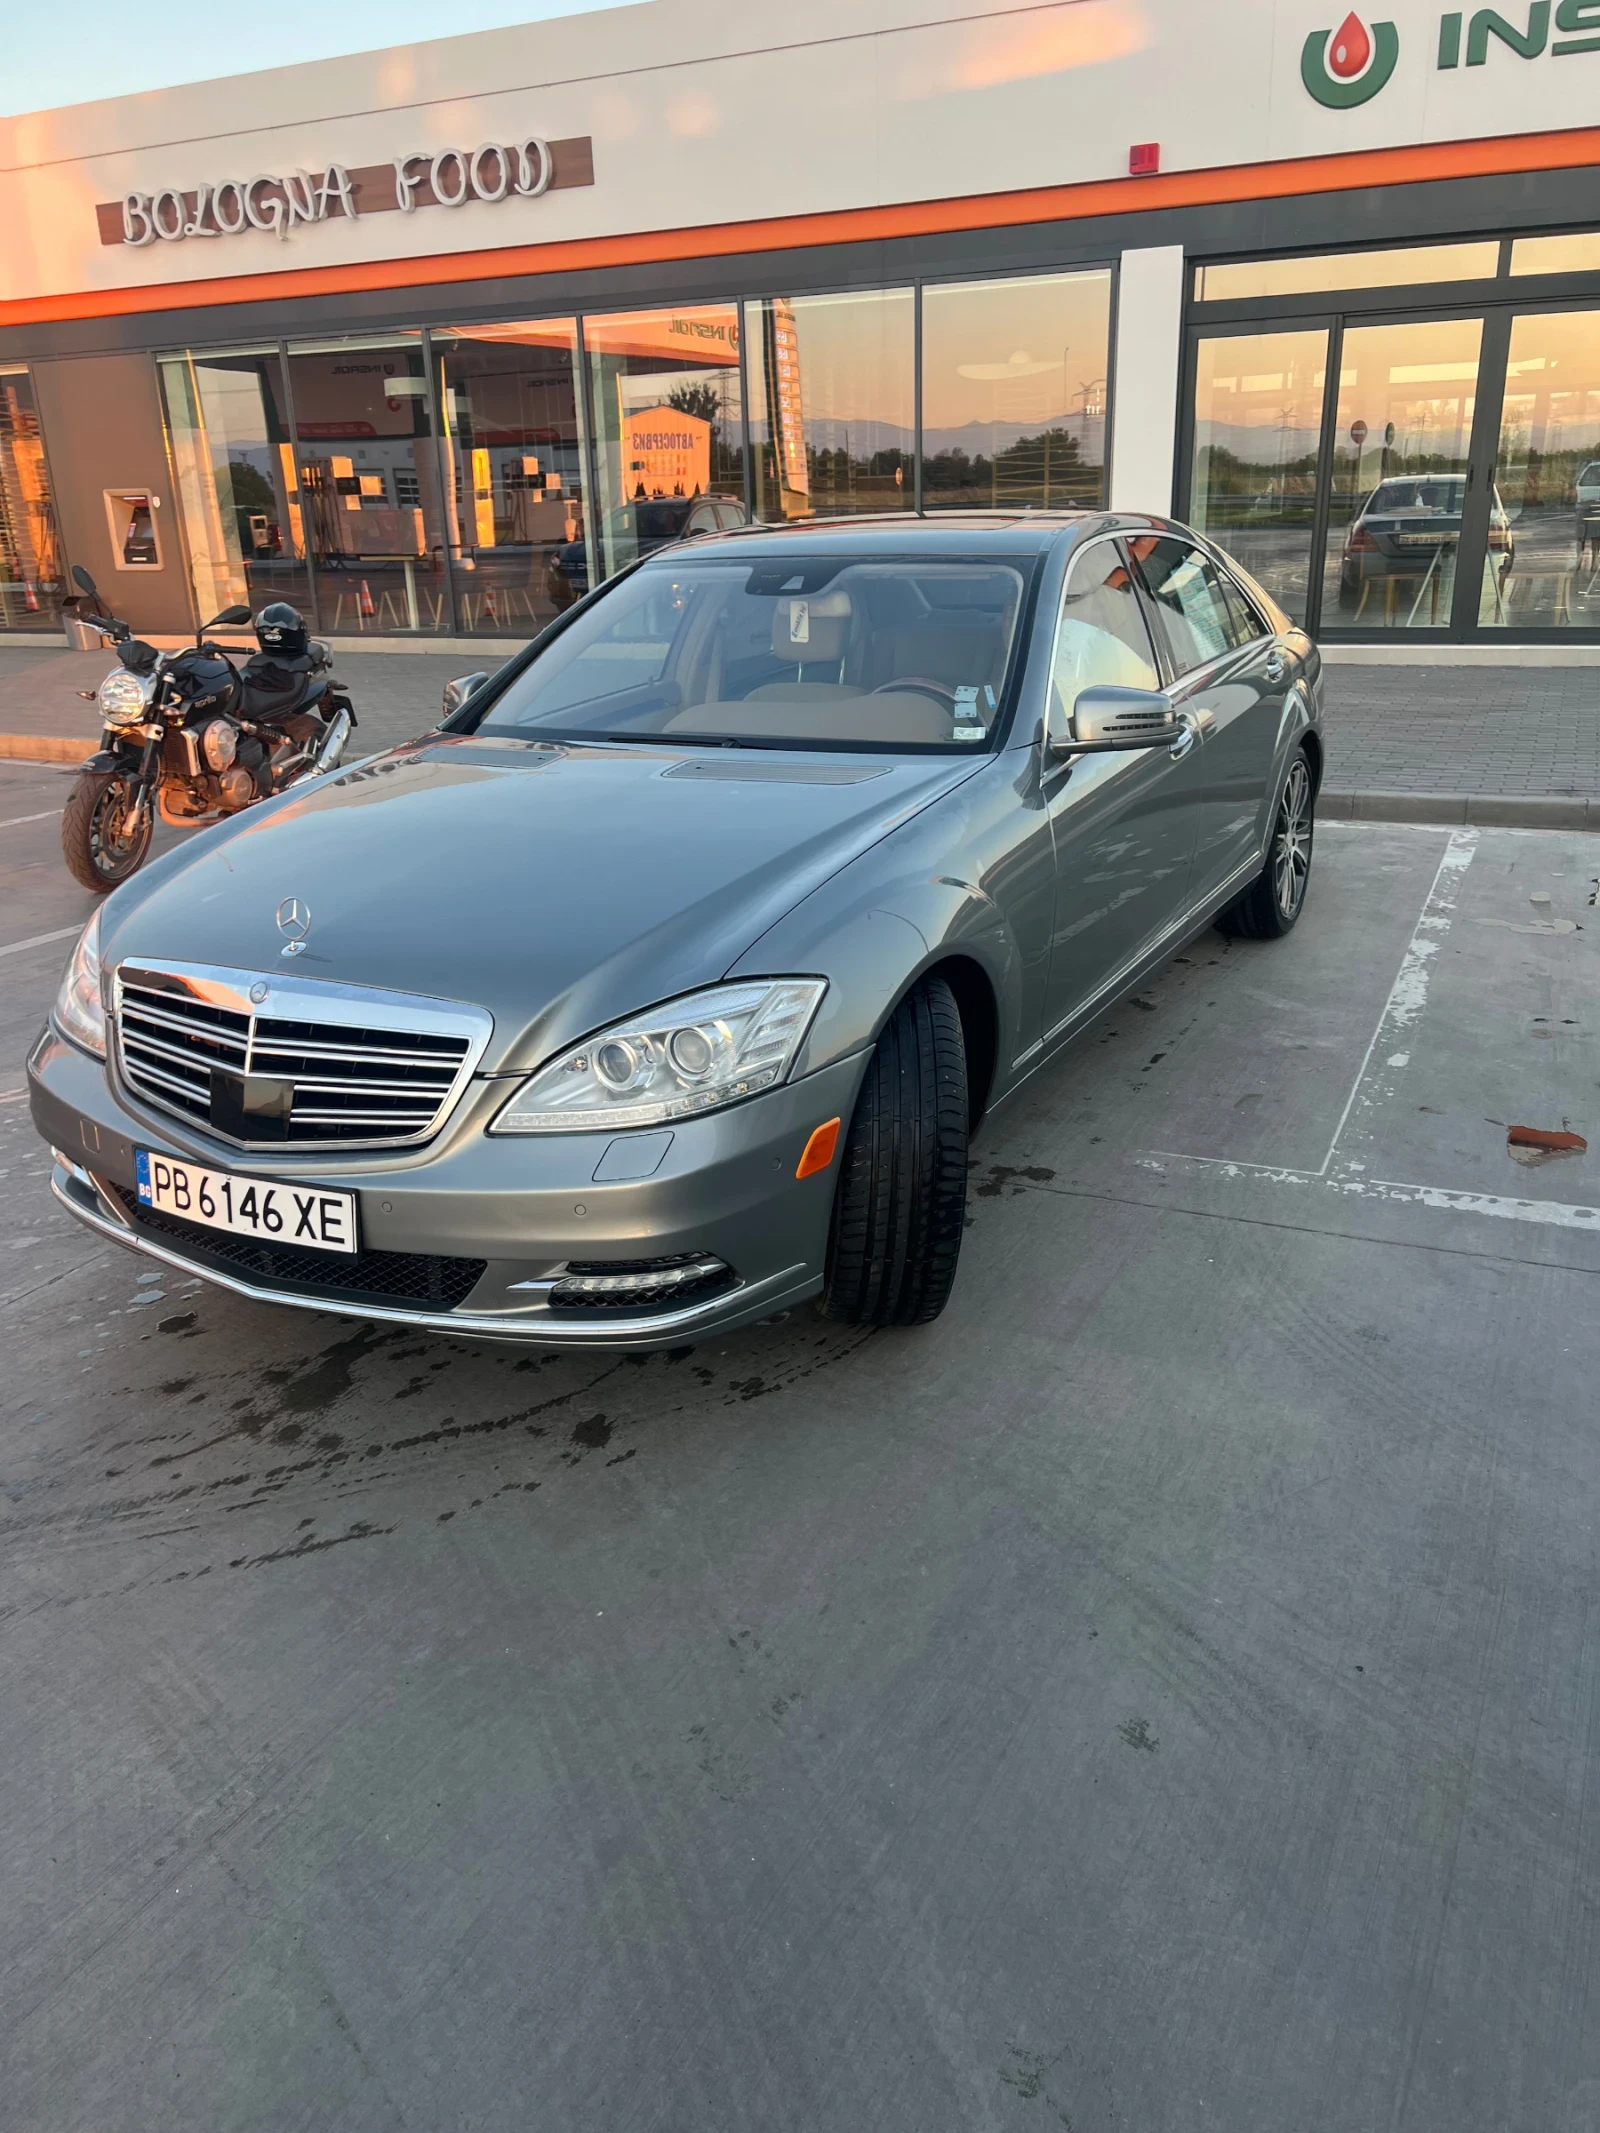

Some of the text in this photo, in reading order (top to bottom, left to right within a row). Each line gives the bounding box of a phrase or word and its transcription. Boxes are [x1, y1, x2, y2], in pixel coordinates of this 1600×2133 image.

[123, 137, 553, 246] BOLOGNA FOOD
[139, 1183, 151, 1198] BG
[154, 1161, 345, 1244] PB 6146 XE
